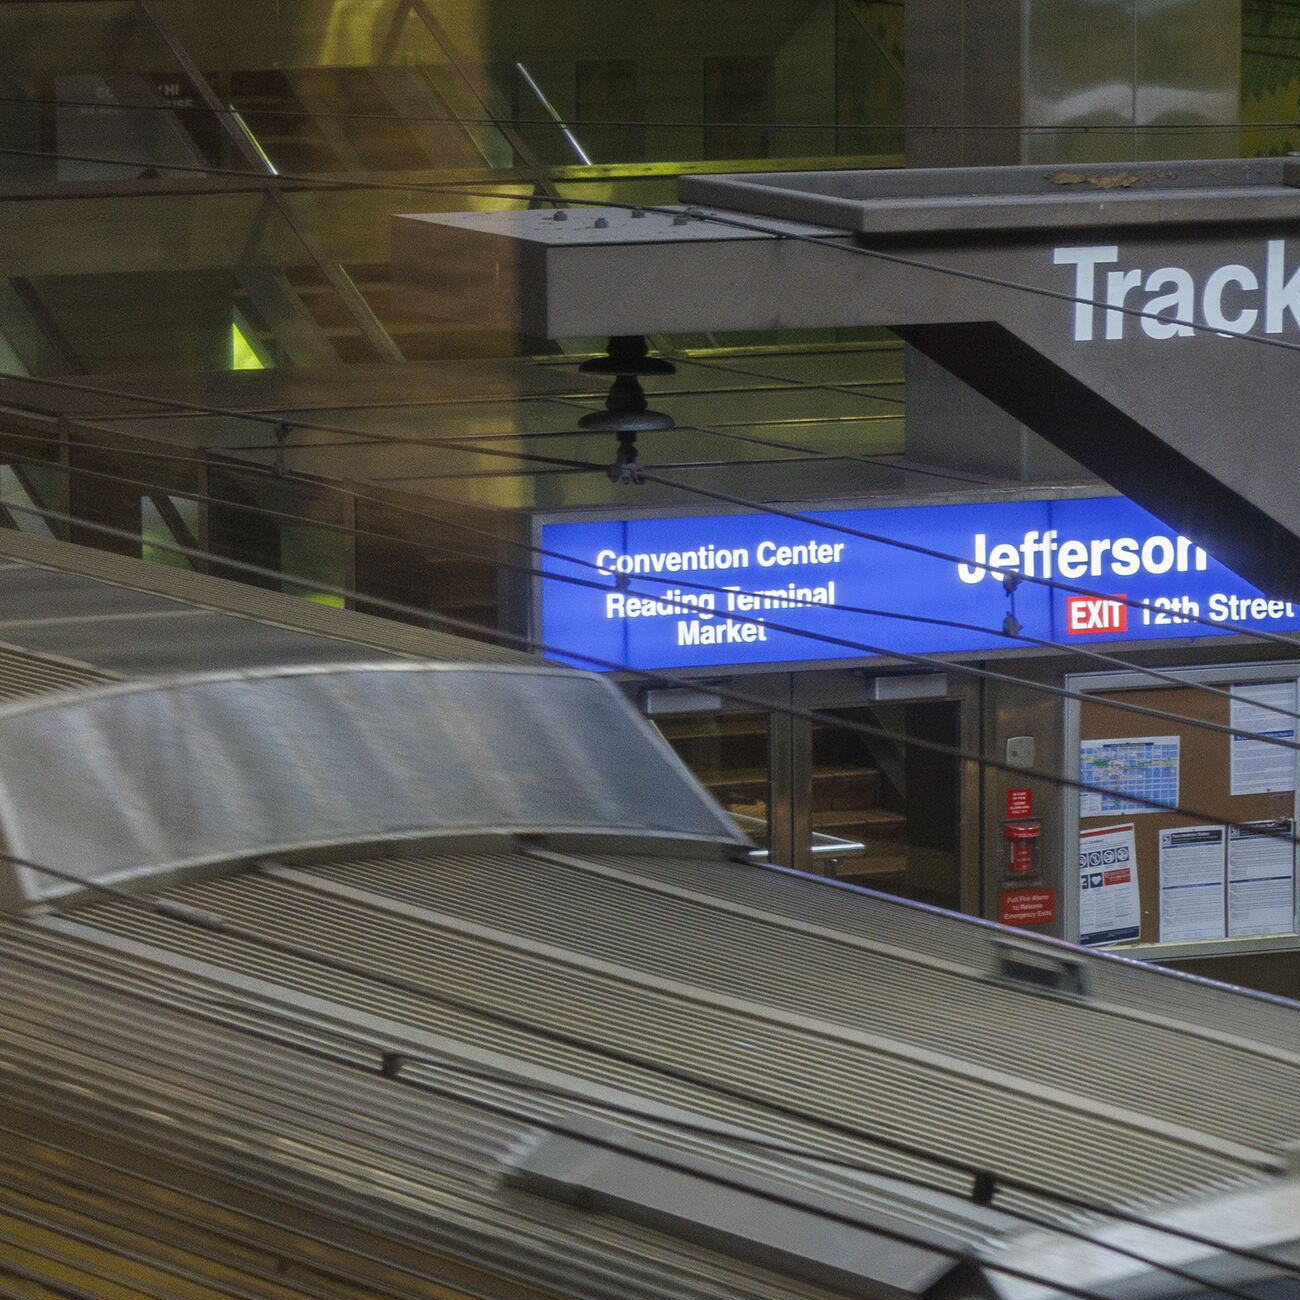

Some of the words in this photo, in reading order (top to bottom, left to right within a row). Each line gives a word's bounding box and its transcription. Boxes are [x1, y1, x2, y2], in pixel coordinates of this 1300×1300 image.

[597, 547, 748, 575] Convention
[757, 541, 844, 567] Center
[958, 530, 1207, 583] Jefferson
[606, 588, 715, 619] Reading
[727, 581, 836, 612] Terminal
[1071, 600, 1123, 630] EXIT
[1142, 596, 1200, 626] 12th
[1209, 592, 1294, 624] Street
[677, 618, 767, 646] Market
